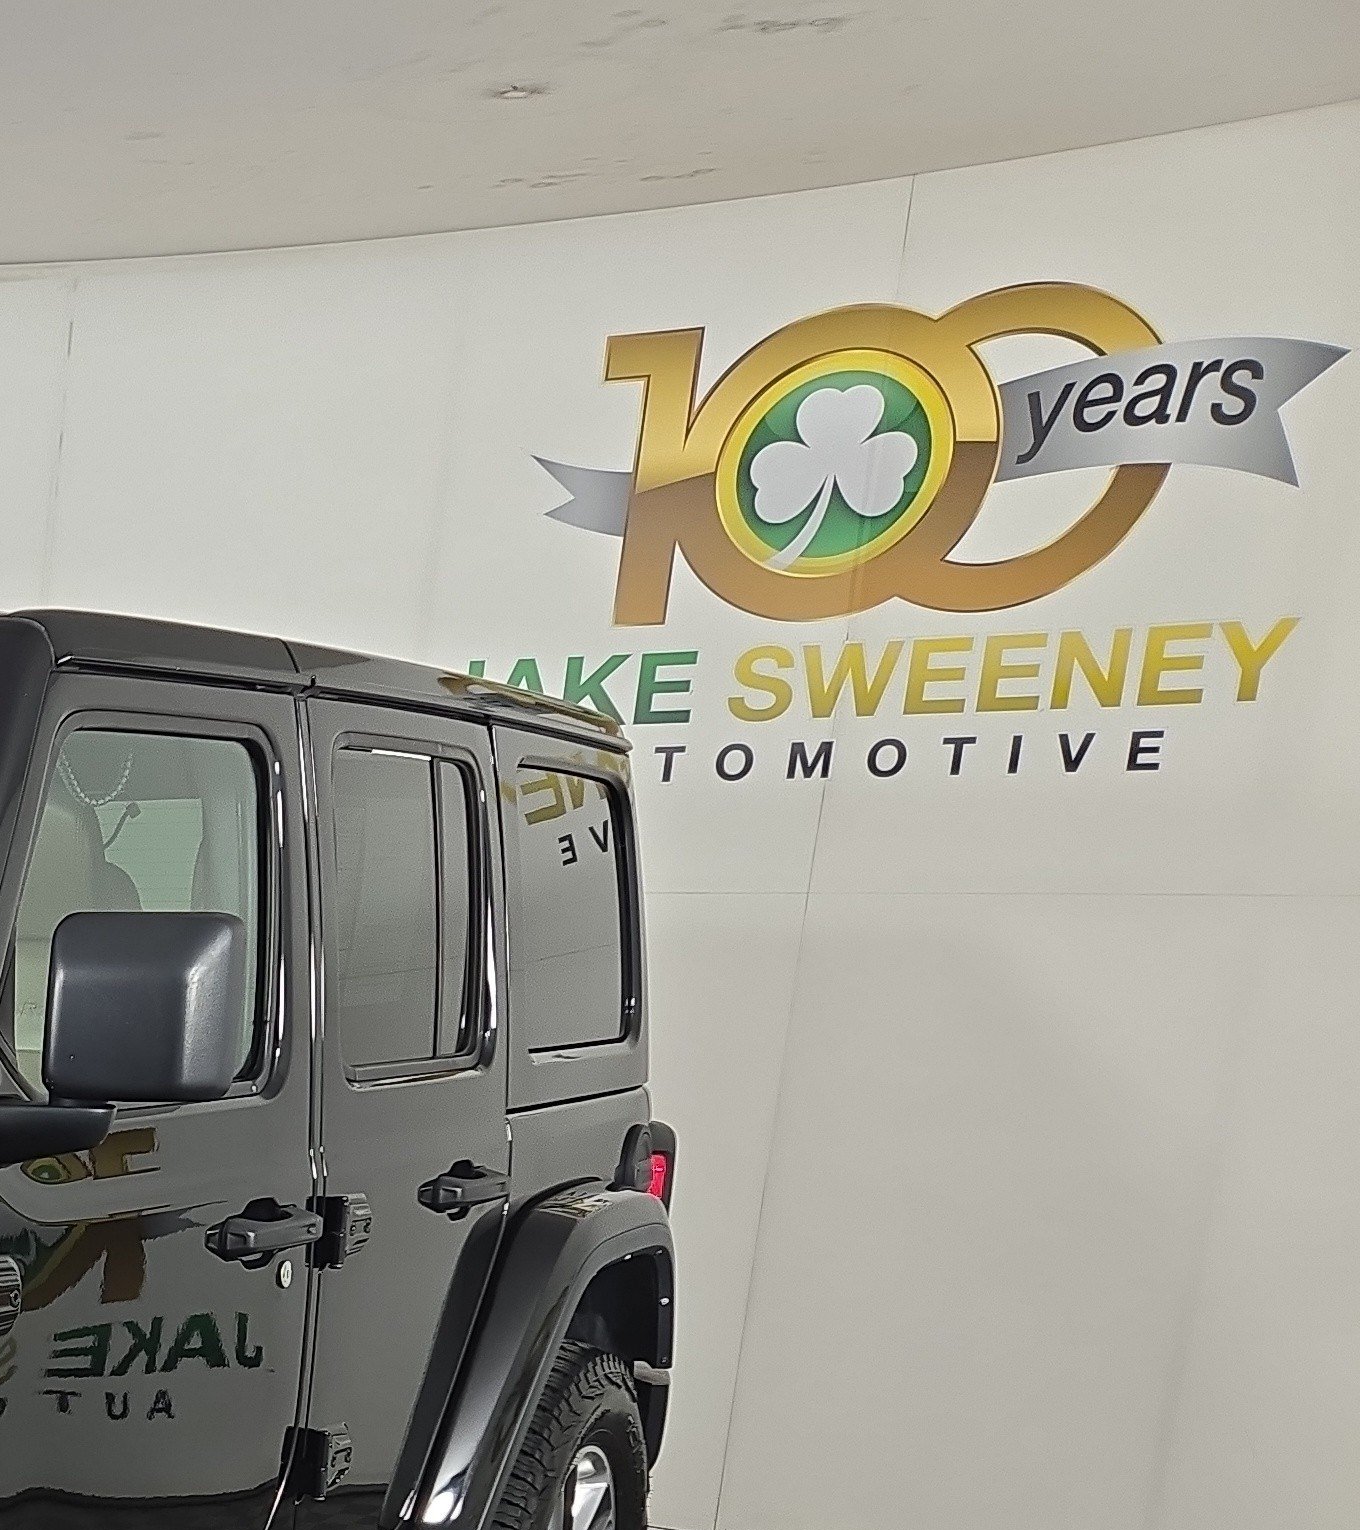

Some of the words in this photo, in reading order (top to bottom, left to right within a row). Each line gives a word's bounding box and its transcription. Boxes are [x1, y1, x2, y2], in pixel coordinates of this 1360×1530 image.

[604, 280, 1171, 627] 100
[1016, 356, 1264, 467] years
[726, 616, 1301, 723] SWEENEY
[652, 729, 1166, 783] TOMOTIVE
